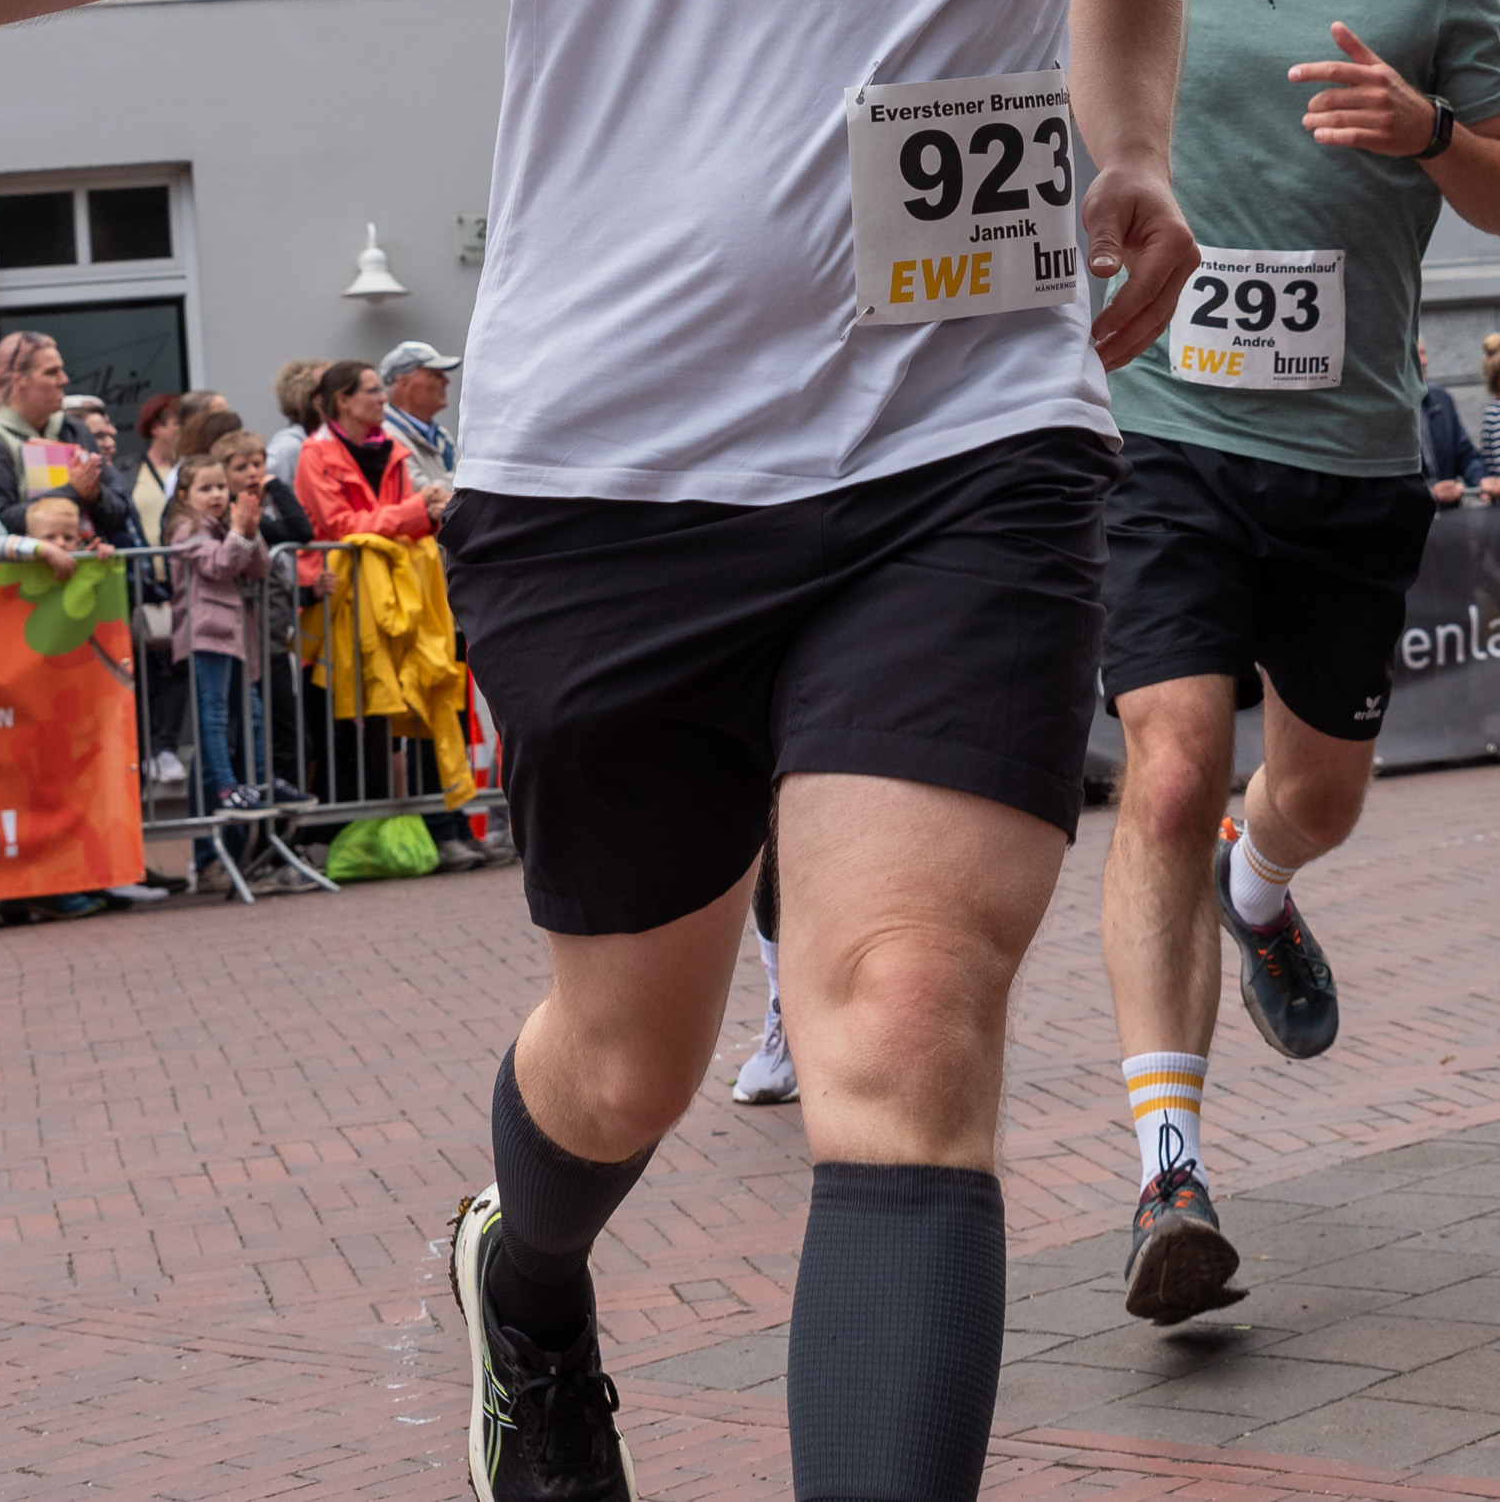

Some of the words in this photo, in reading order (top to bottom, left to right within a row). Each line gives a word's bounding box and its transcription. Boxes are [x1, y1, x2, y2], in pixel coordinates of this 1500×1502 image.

[870, 99, 985, 123] Everstener
[899, 117, 1072, 221] 923
[969, 219, 1038, 243] Jannik
[889, 251, 993, 304] EWE
[1033, 241, 1077, 281] bru
[1201, 261, 1251, 273] rstener
[1255, 262, 1337, 274] Brunnenlauf
[1190, 275, 1320, 333] 293
[1232, 335, 1276, 348] André
[1180, 344, 1245, 377] EWE
[1273, 351, 1330, 374] bruns
